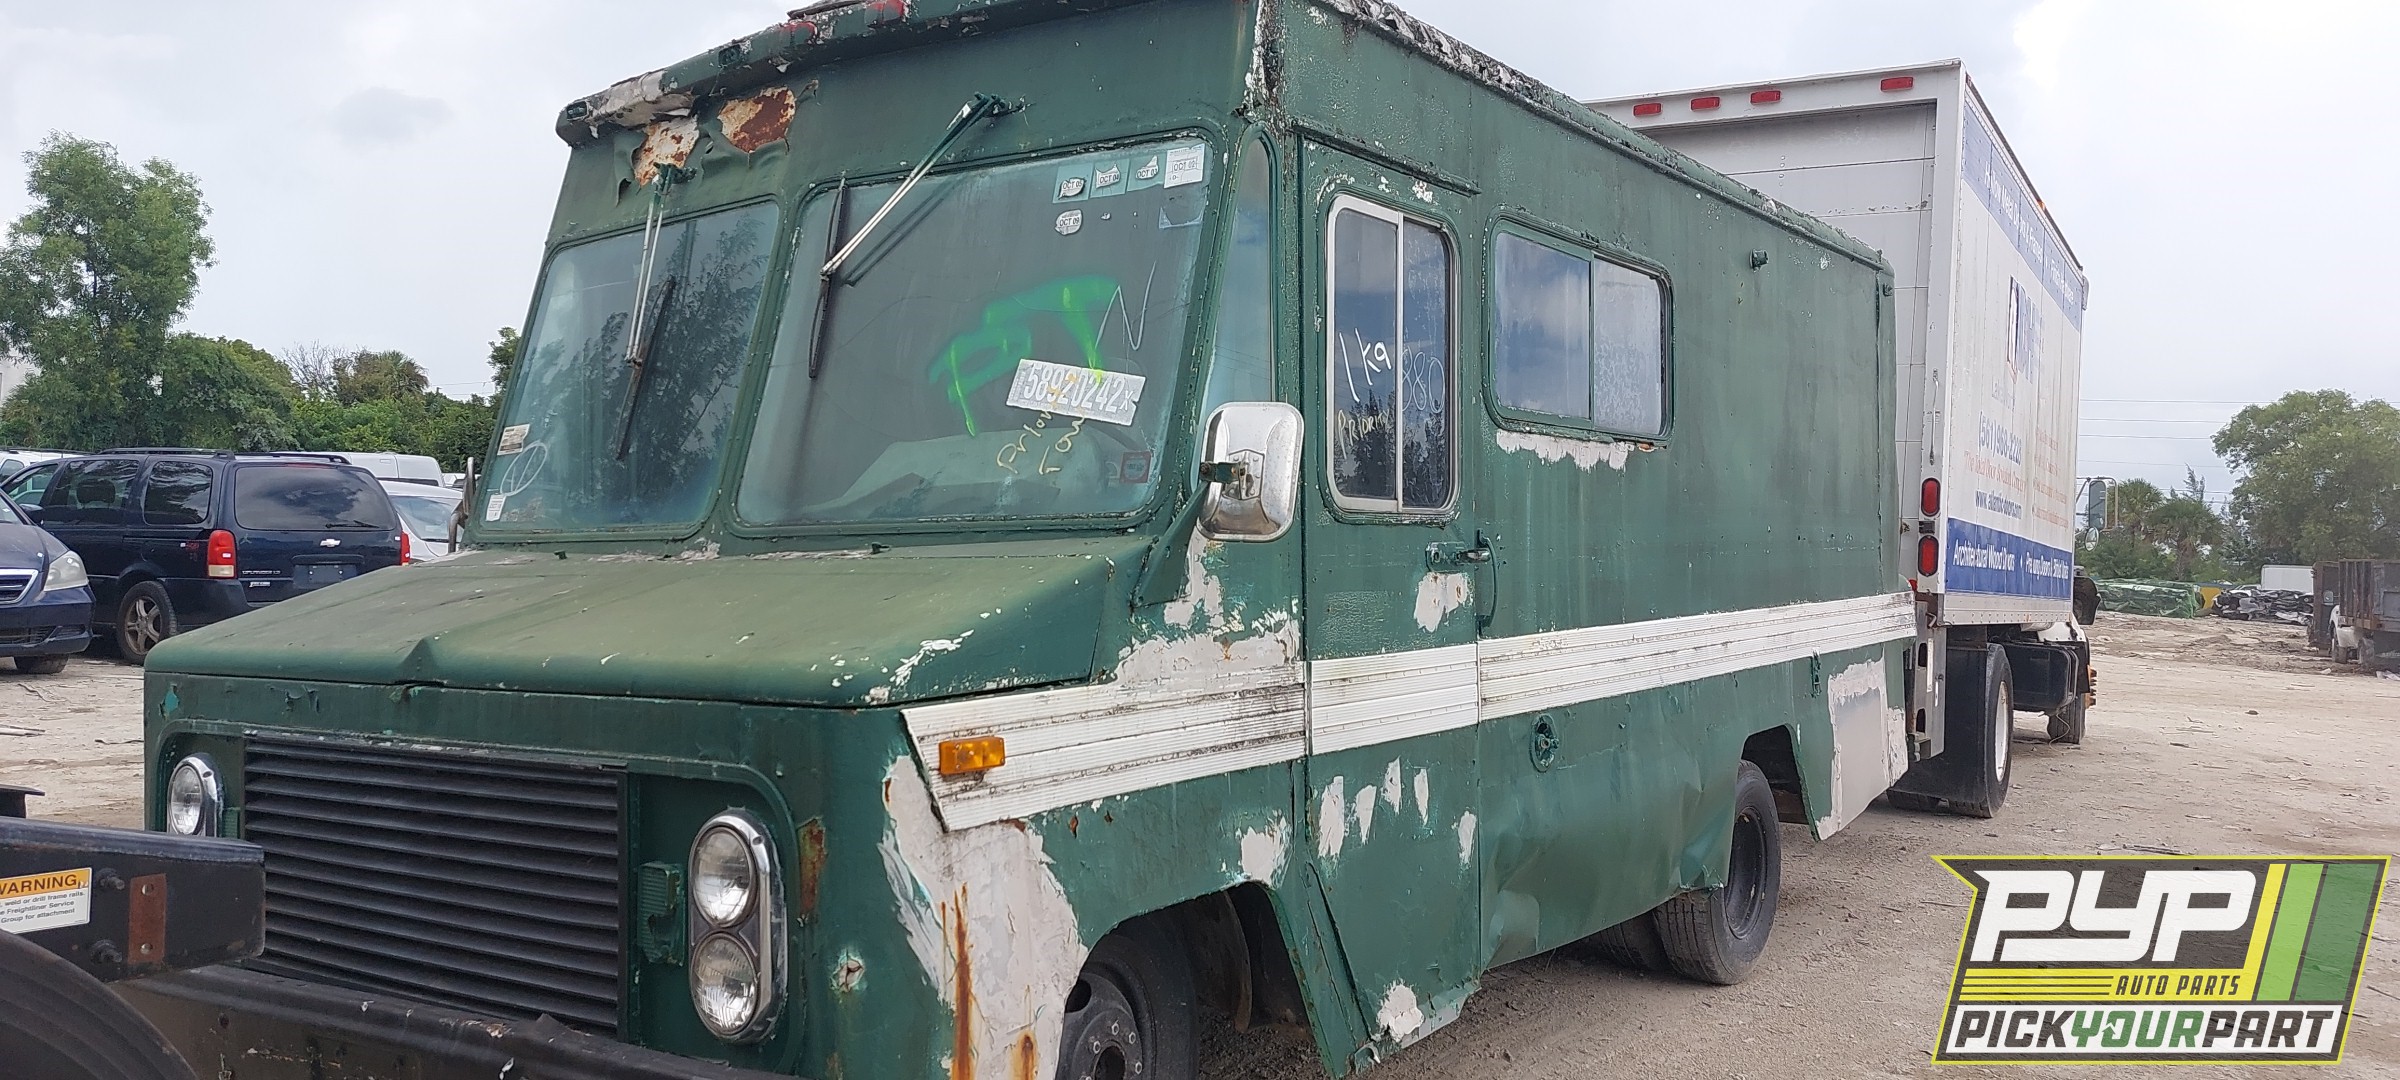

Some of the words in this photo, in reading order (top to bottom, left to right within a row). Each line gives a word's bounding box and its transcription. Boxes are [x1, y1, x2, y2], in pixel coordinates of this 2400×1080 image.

[1173, 162, 1186, 171] OCT
[1137, 170, 1149, 178] OCT
[1100, 175, 1112, 184] OCT
[1063, 181, 1075, 190] OCT
[1060, 218, 1072, 227] OCT
[5, 898, 21, 906] weld
[7, 904, 47, 915] Freightliner
[49, 901, 74, 909] Service
[1, 916, 24, 924] Group
[37, 908, 75, 919] attachment
